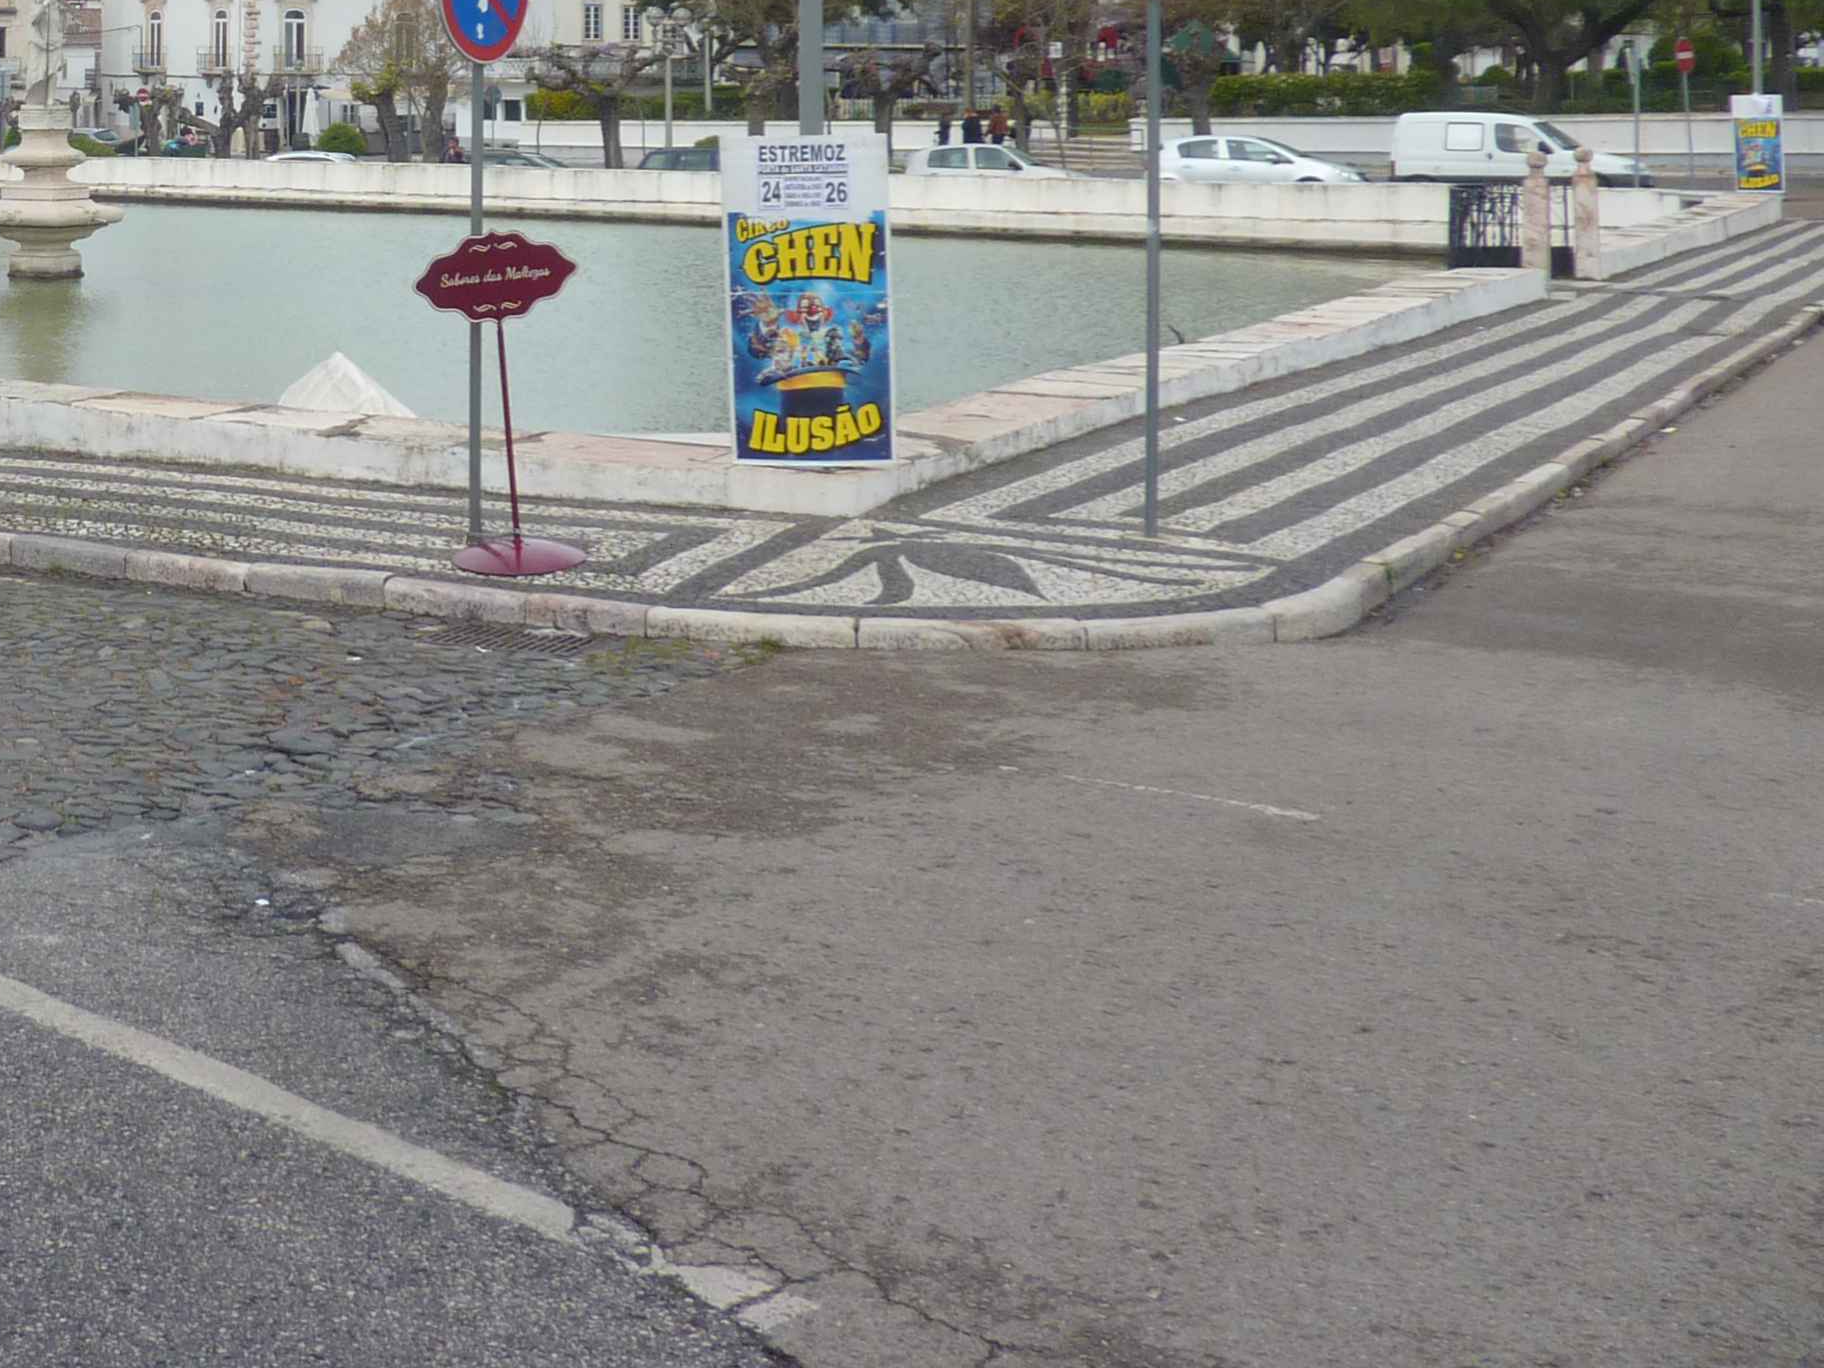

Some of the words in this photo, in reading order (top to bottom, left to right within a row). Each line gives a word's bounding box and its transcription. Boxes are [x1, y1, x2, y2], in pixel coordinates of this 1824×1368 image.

[758, 143, 846, 163] ESTREMOZ
[761, 180, 781, 203] 24
[825, 181, 848, 203] 26
[743, 222, 877, 284] CHEN
[439, 272, 481, 288] Sabores
[482, 268, 503, 283] das
[749, 402, 882, 454] ILUSÃO
